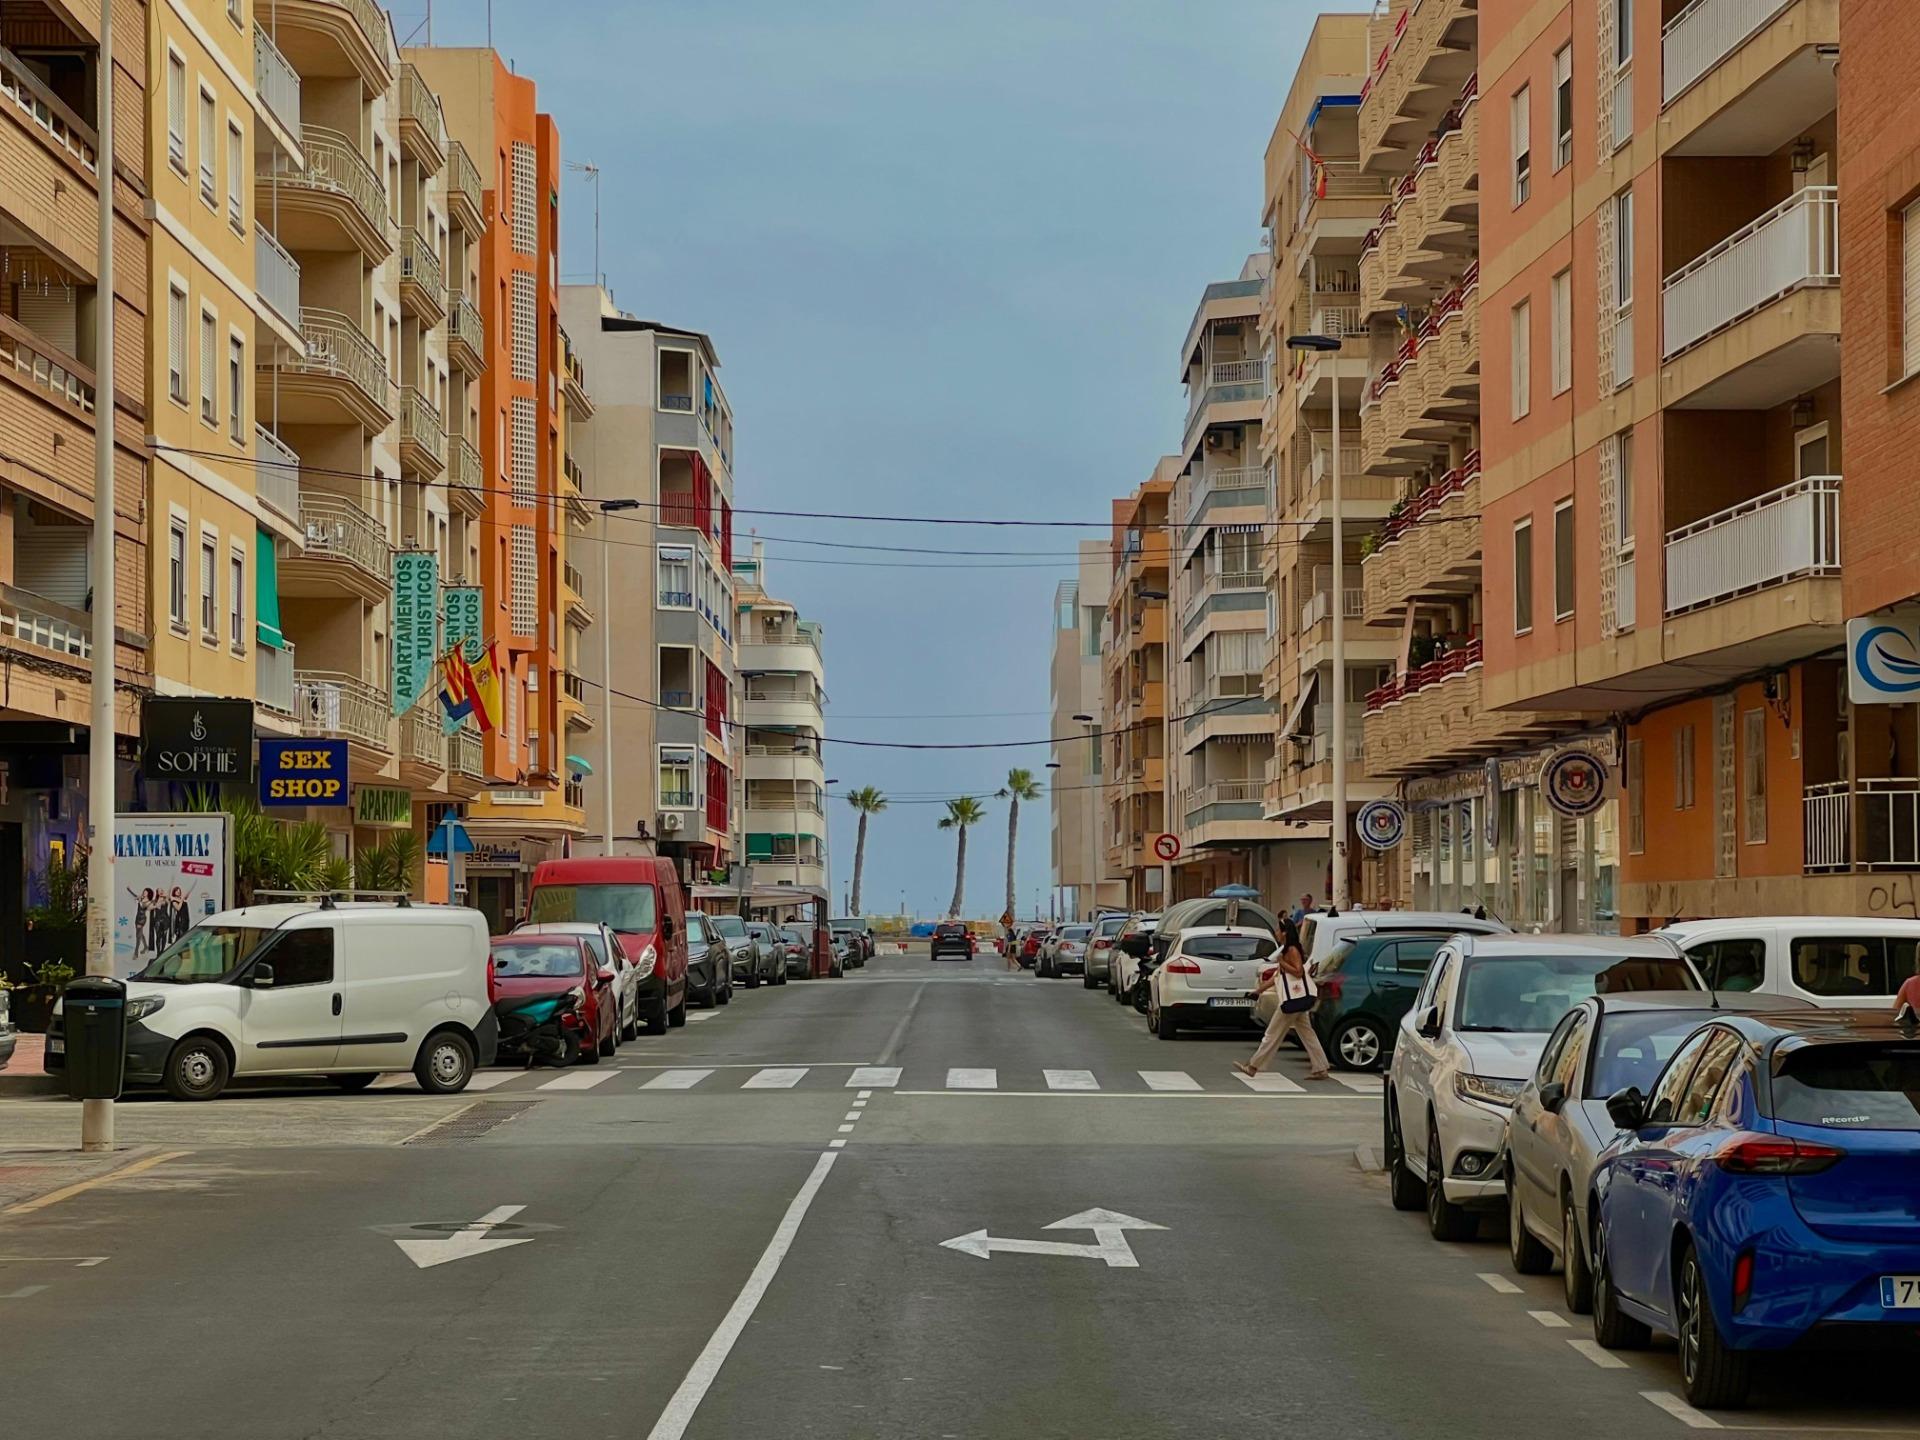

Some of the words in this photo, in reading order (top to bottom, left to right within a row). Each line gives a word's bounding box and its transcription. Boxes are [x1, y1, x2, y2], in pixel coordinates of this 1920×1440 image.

[416, 558, 433, 661] TURISTICOS
[396, 558, 413, 699] APARTAMENTOS
[446, 593, 461, 651] ENTOS
[157, 750, 237, 772] SOPHIE
[279, 750, 332, 769] SEX
[270, 779, 341, 798] SHOP
[114, 833, 171, 857] MAMMA
[174, 832, 210, 857] MIA!
[1900, 1280, 1920, 1304] 7
